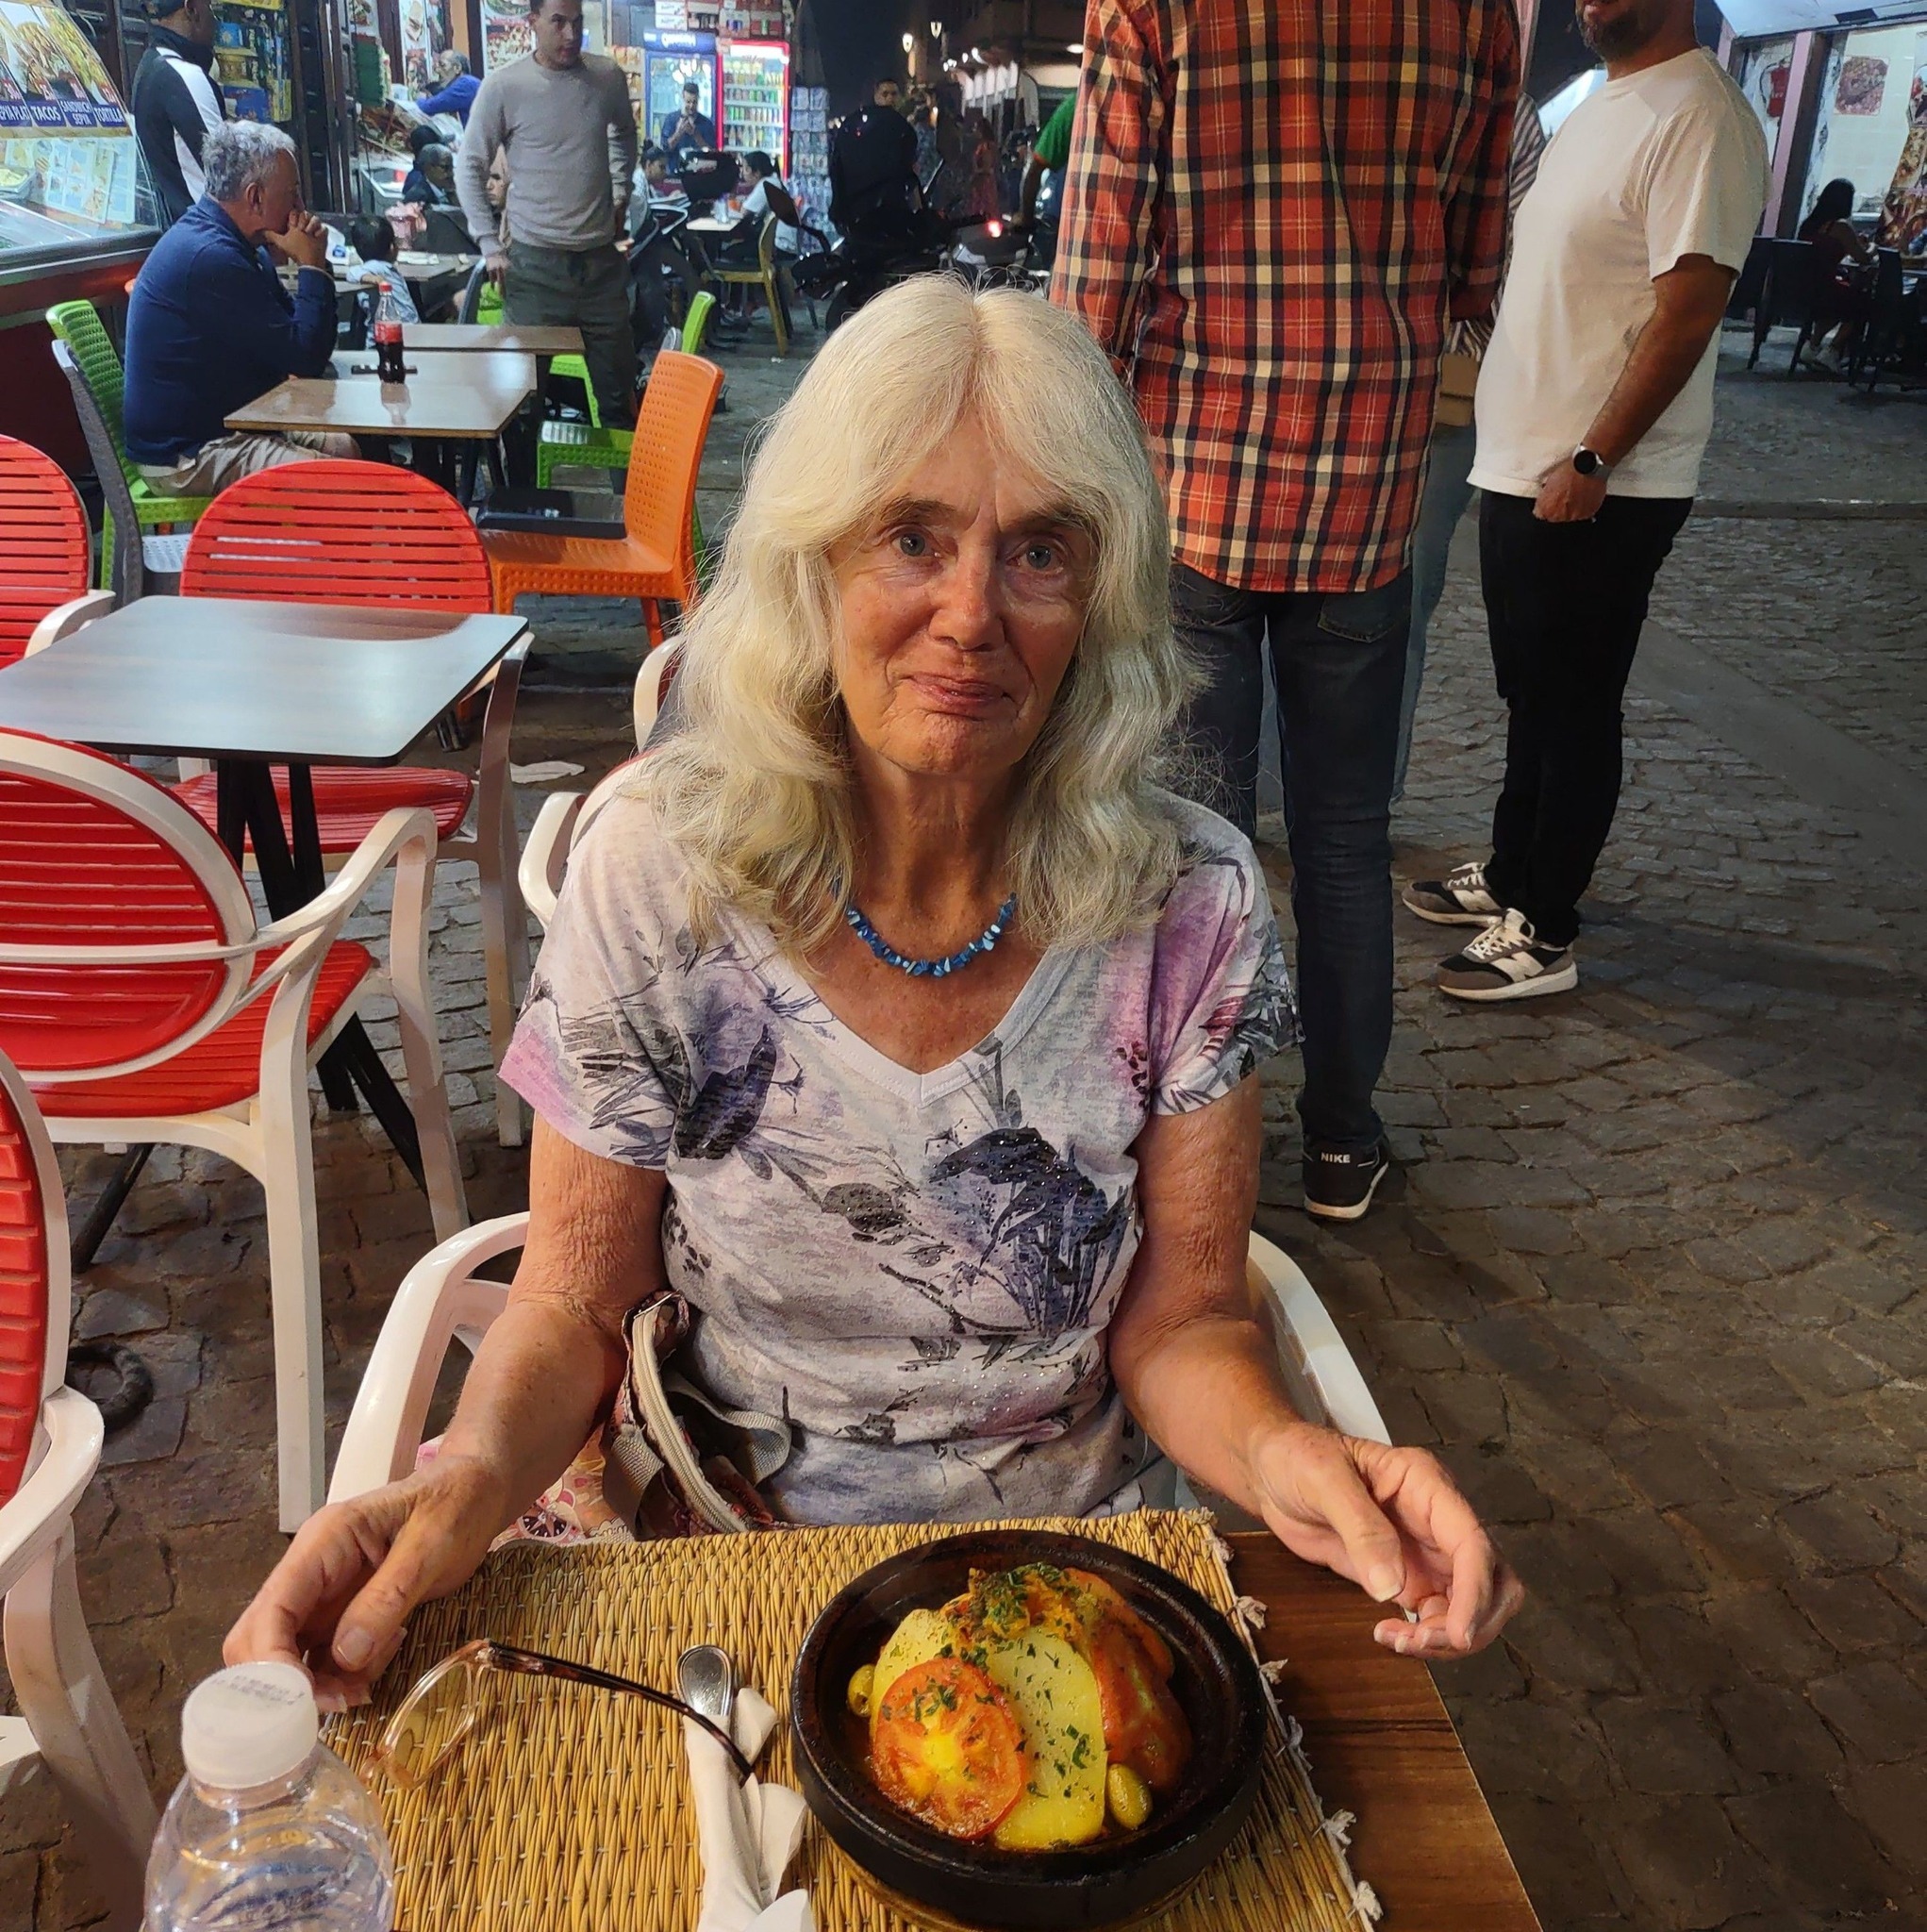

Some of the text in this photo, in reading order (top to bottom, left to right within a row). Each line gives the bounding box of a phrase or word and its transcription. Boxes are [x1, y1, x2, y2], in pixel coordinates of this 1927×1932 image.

[59, 100, 92, 113] SANDWICH
[30, 106, 61, 122] TACOS
[93, 108, 125, 123] TORTILLA
[1321, 1152, 1351, 1164] NIKE
